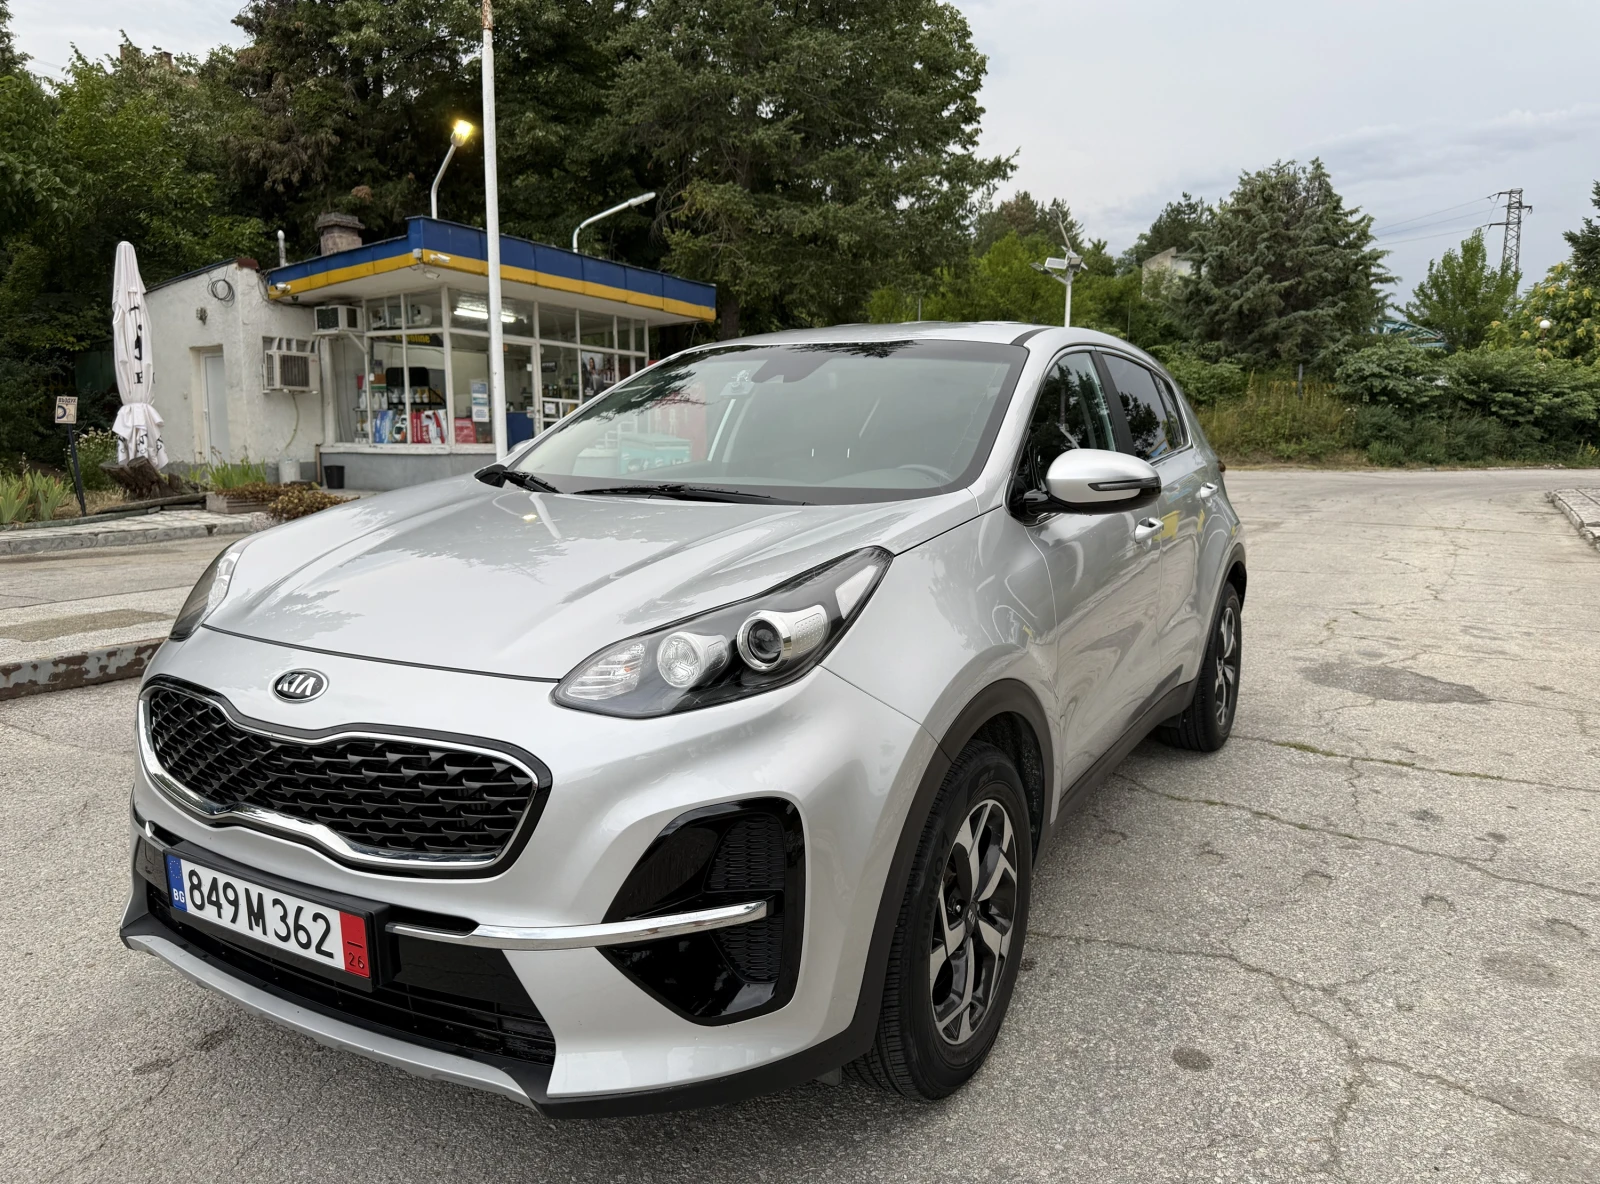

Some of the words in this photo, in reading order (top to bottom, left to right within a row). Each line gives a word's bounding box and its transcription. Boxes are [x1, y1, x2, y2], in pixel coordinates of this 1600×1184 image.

[277, 674, 316, 696] KIA
[173, 888, 185, 903] BG
[348, 951, 365, 970] 26
